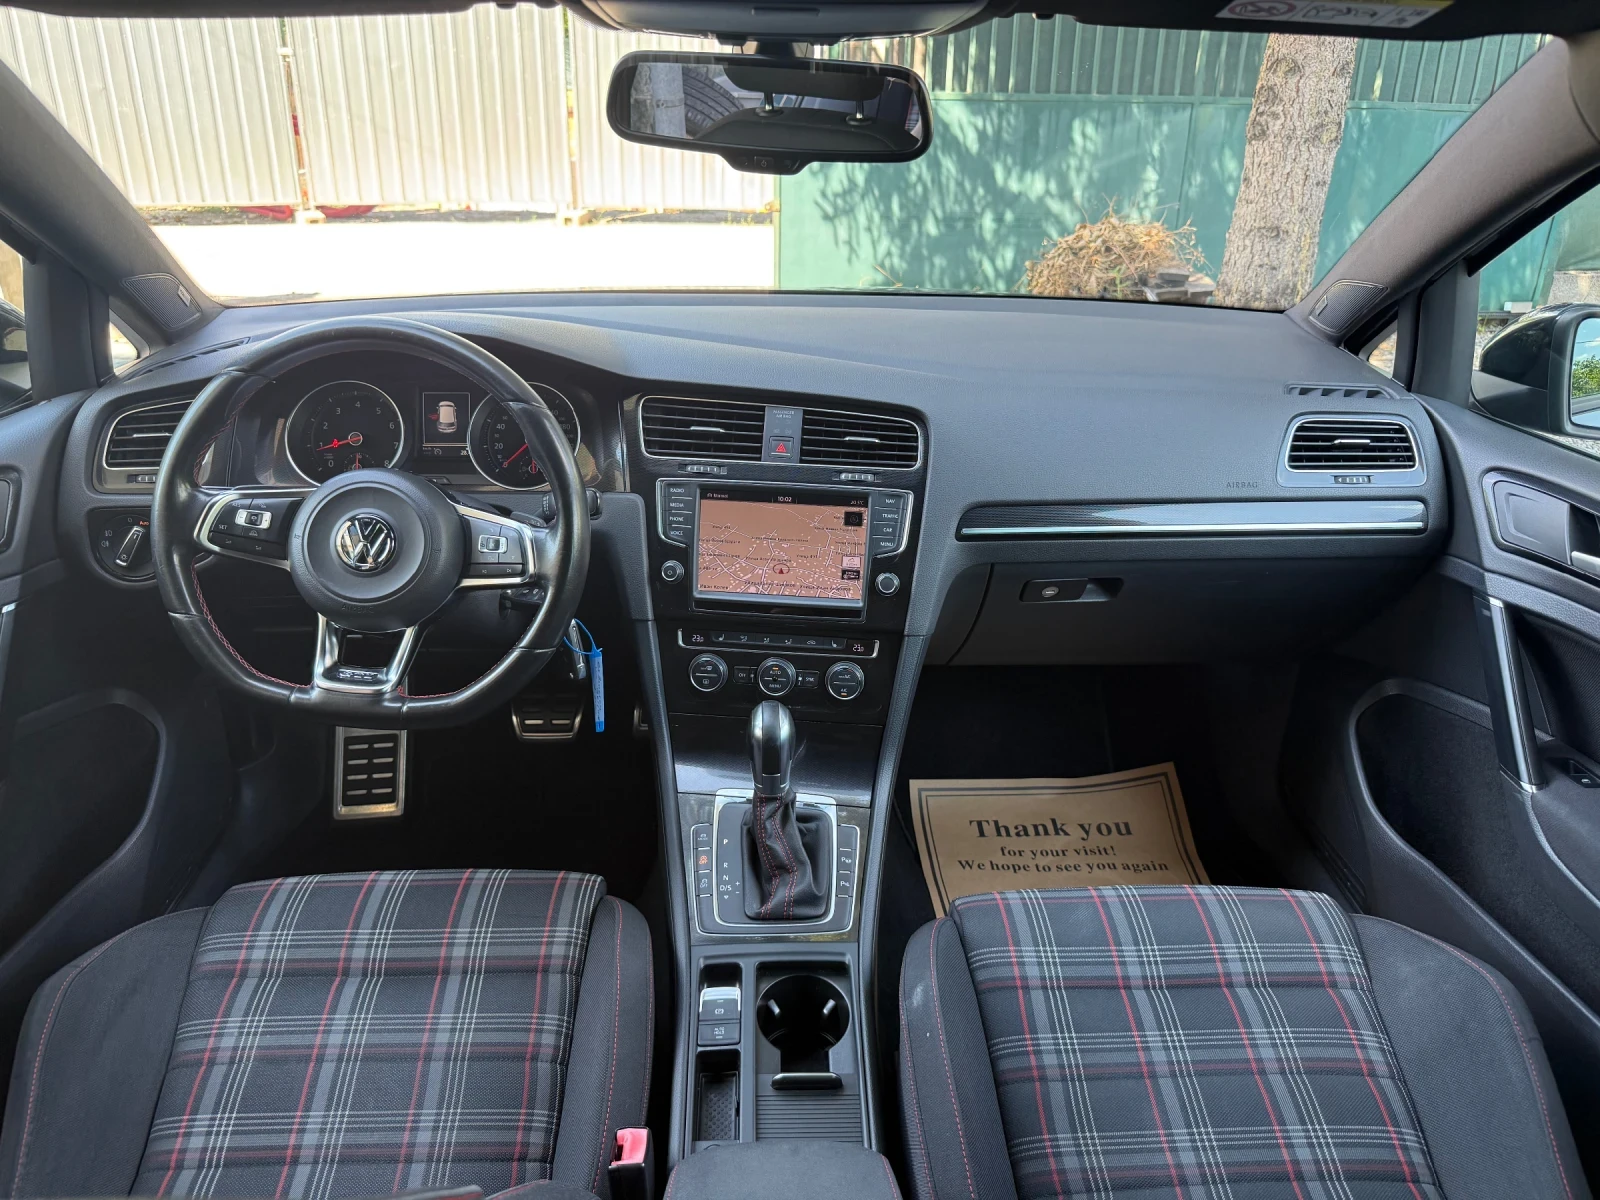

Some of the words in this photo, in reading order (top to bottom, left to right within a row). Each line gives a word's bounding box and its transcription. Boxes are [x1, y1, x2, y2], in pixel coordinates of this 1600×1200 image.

[336, 407, 341, 415] 3
[376, 407, 381, 415] 5
[969, 818, 1071, 838] Thank
[1077, 818, 1133, 841] you
[1000, 846, 1025, 858] for
[1031, 847, 1068, 860] your
[1074, 845, 1116, 857] visit!
[957, 859, 986, 871] We
[990, 860, 1031, 874] hope
[1035, 861, 1051, 872] to
[1056, 860, 1082, 872] see
[1088, 860, 1118, 874] you
[1122, 860, 1170, 873] again
